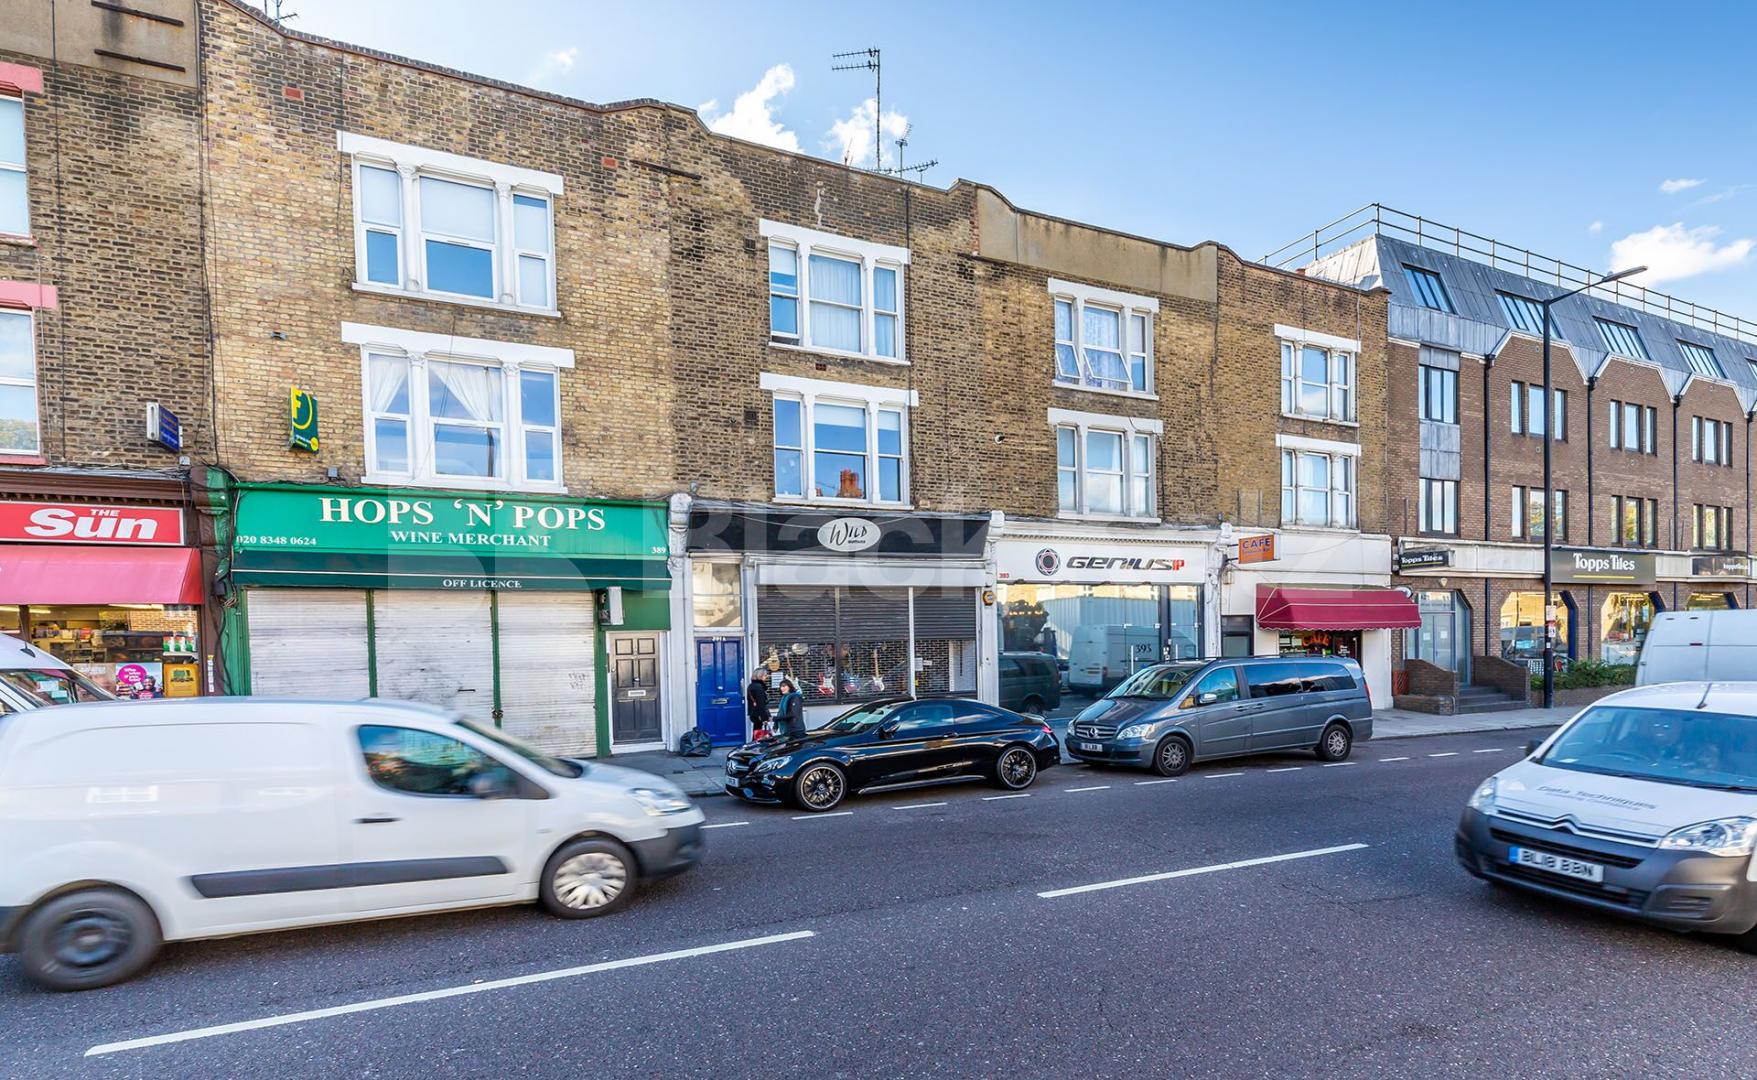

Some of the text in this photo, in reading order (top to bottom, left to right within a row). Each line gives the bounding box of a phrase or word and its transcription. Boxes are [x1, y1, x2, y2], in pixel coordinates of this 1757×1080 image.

[90, 509, 120, 517] THE
[319, 498, 434, 525] HOPS
[512, 505, 606, 531] POPS
[24, 508, 158, 540] Sun
[260, 536, 287, 545] 8348
[290, 537, 317, 546] 0624
[391, 530, 551, 547] WINE MERCHANT
[1242, 537, 1271, 549] CAFE
[651, 546, 667, 554] 389
[1401, 556, 1421, 564] Topps
[1573, 553, 1635, 572] Topps Tiles
[442, 579, 522, 589] OFF LICENCE
[1135, 643, 1152, 653] 393
[1536, 785, 1571, 794] Data
[1575, 790, 1658, 810] Techniques
